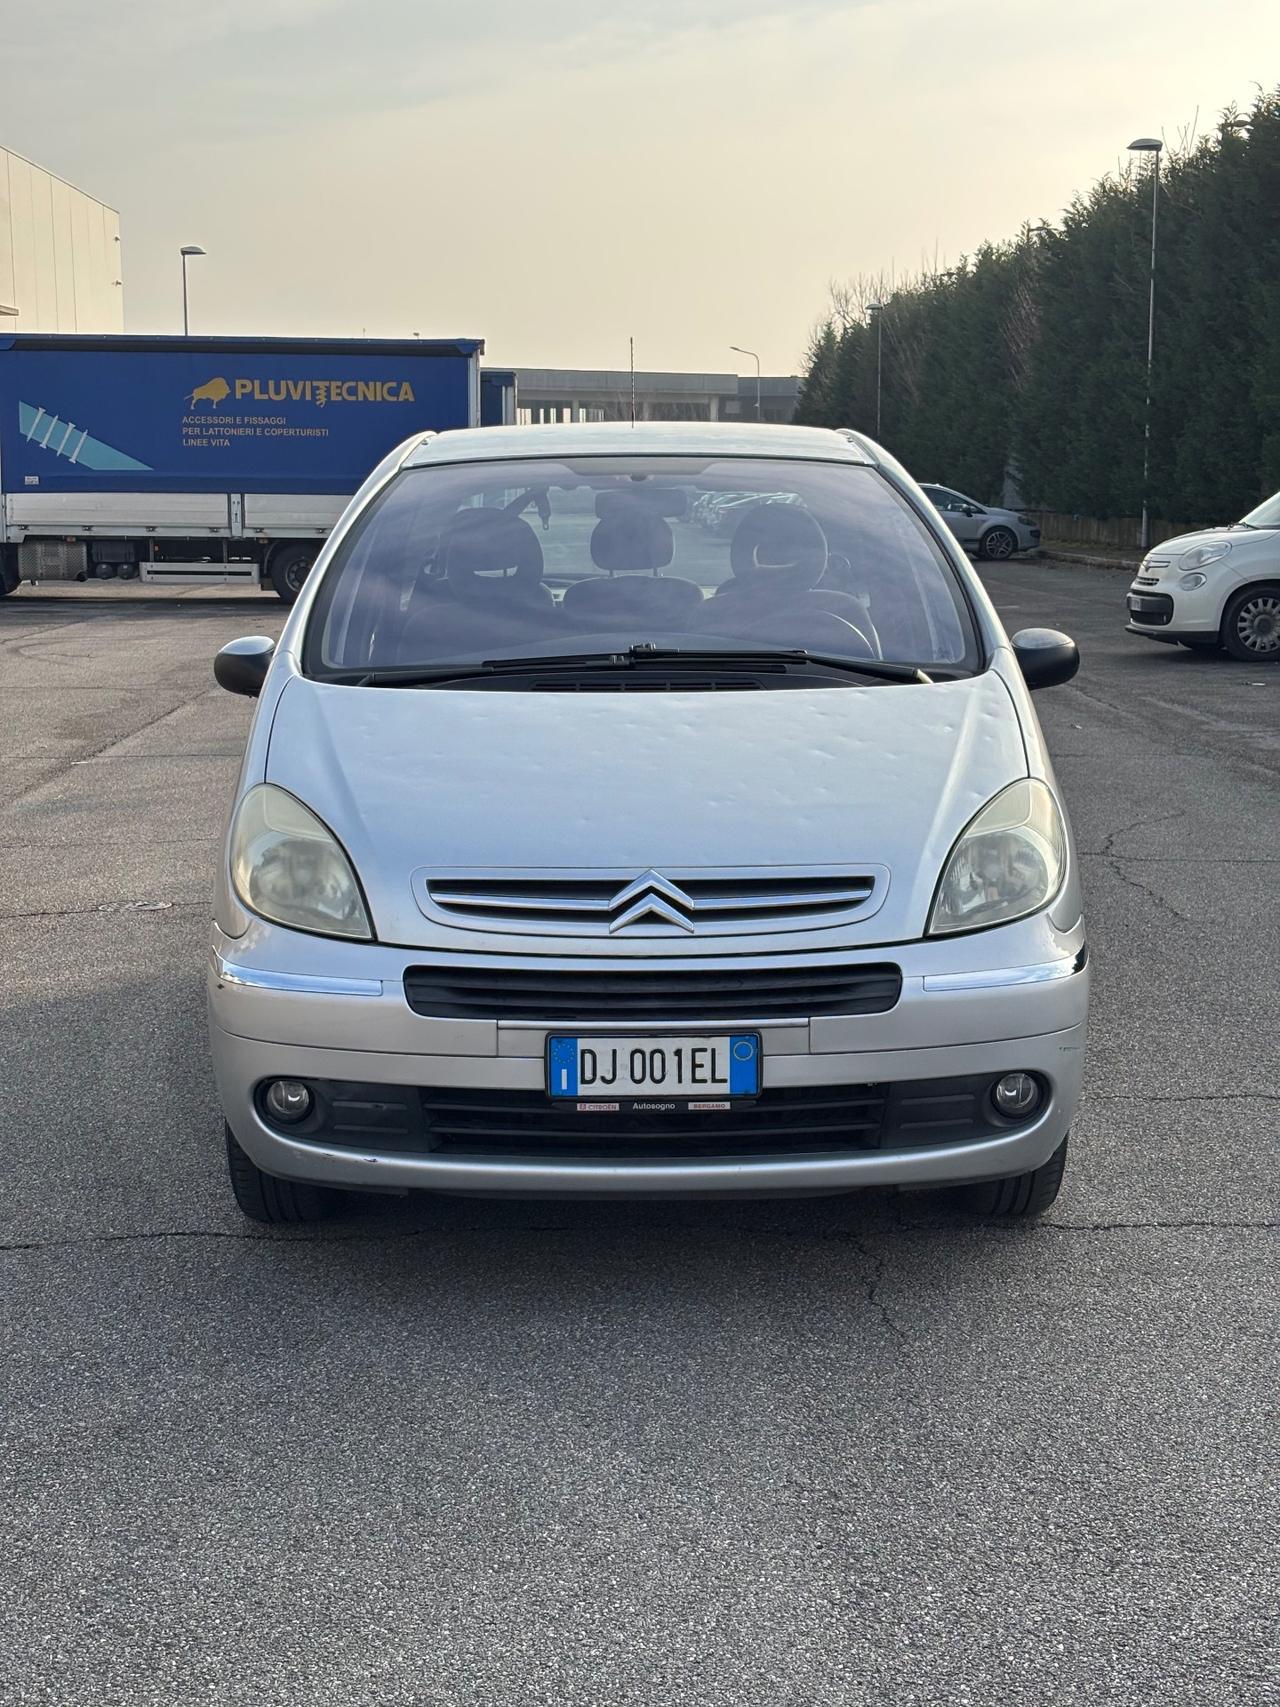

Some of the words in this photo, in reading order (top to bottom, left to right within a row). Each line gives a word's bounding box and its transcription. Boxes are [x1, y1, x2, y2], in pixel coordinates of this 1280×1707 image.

[235, 379, 415, 408] PLUVITECNICA
[182, 416, 234, 424] ACCESSORI
[236, 416, 242, 424] E
[245, 416, 286, 425] FISSAGGI
[182, 427, 201, 435] PER
[203, 427, 254, 436] LATTONIERI
[256, 428, 262, 436] E
[264, 428, 329, 437] COPERTURISTI
[183, 439, 208, 447] LINEE
[211, 439, 230, 447] VITA
[580, 1048, 617, 1085] DJ
[630, 1047, 728, 1084] 001EL
[632, 1102, 676, 1110] Autosogno
